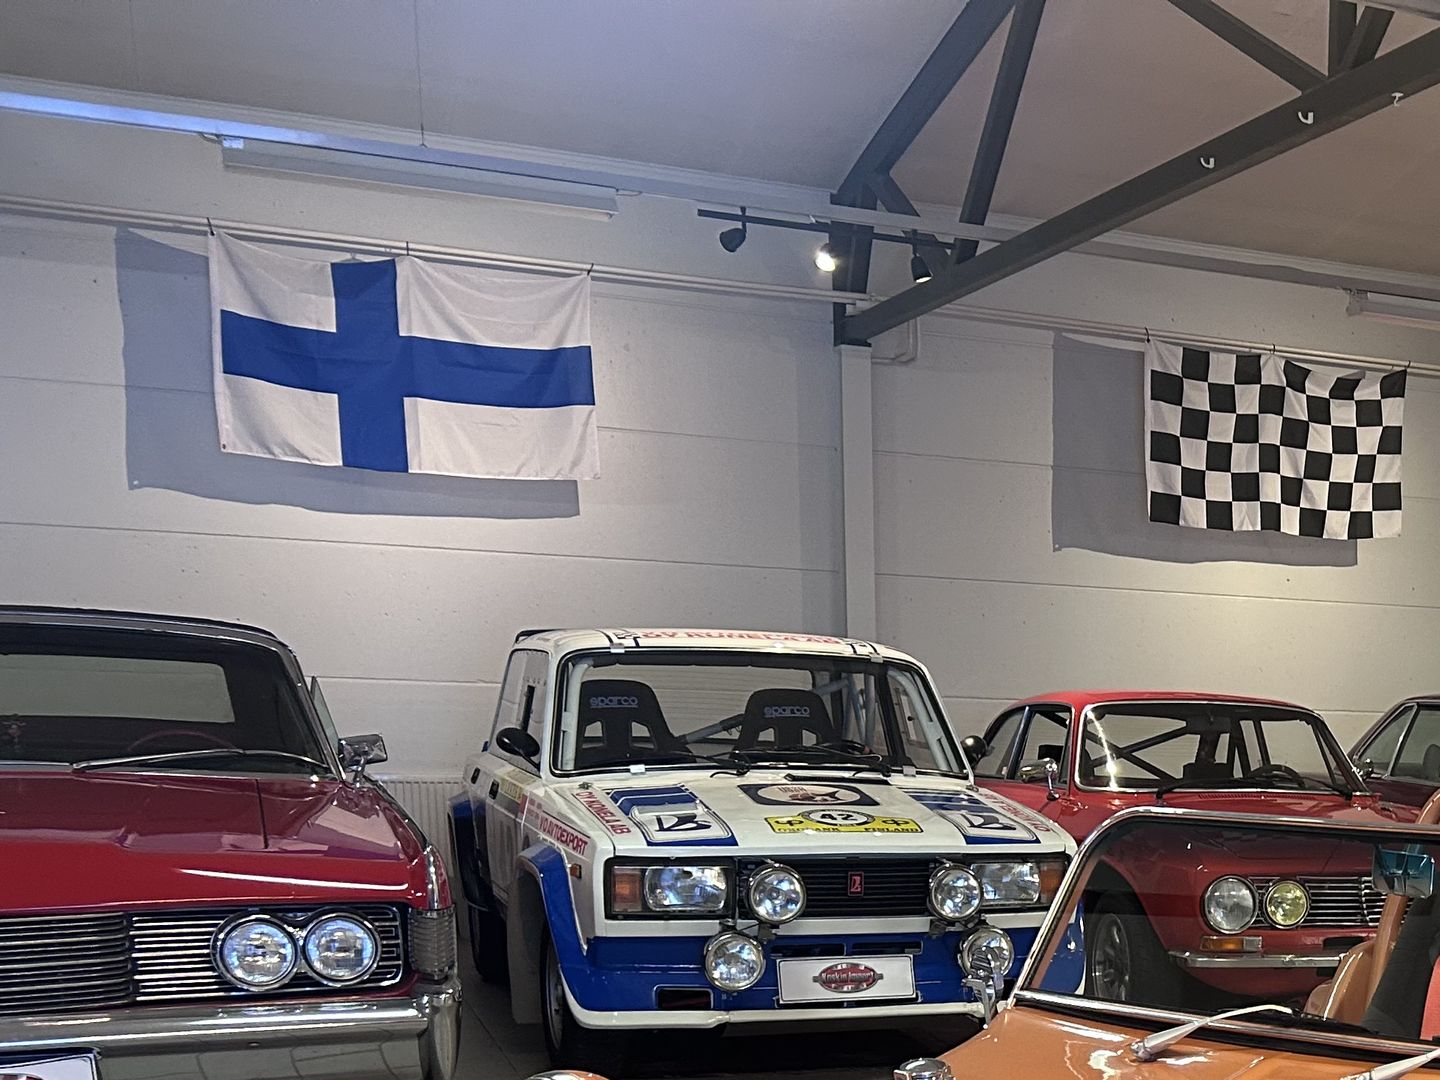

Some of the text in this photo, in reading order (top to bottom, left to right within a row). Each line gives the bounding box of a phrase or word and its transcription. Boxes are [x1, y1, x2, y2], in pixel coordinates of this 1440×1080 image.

[590, 697, 639, 706] sparco
[764, 706, 810, 716] sparco
[819, 813, 855, 822] 42
[608, 824, 631, 834] AB
